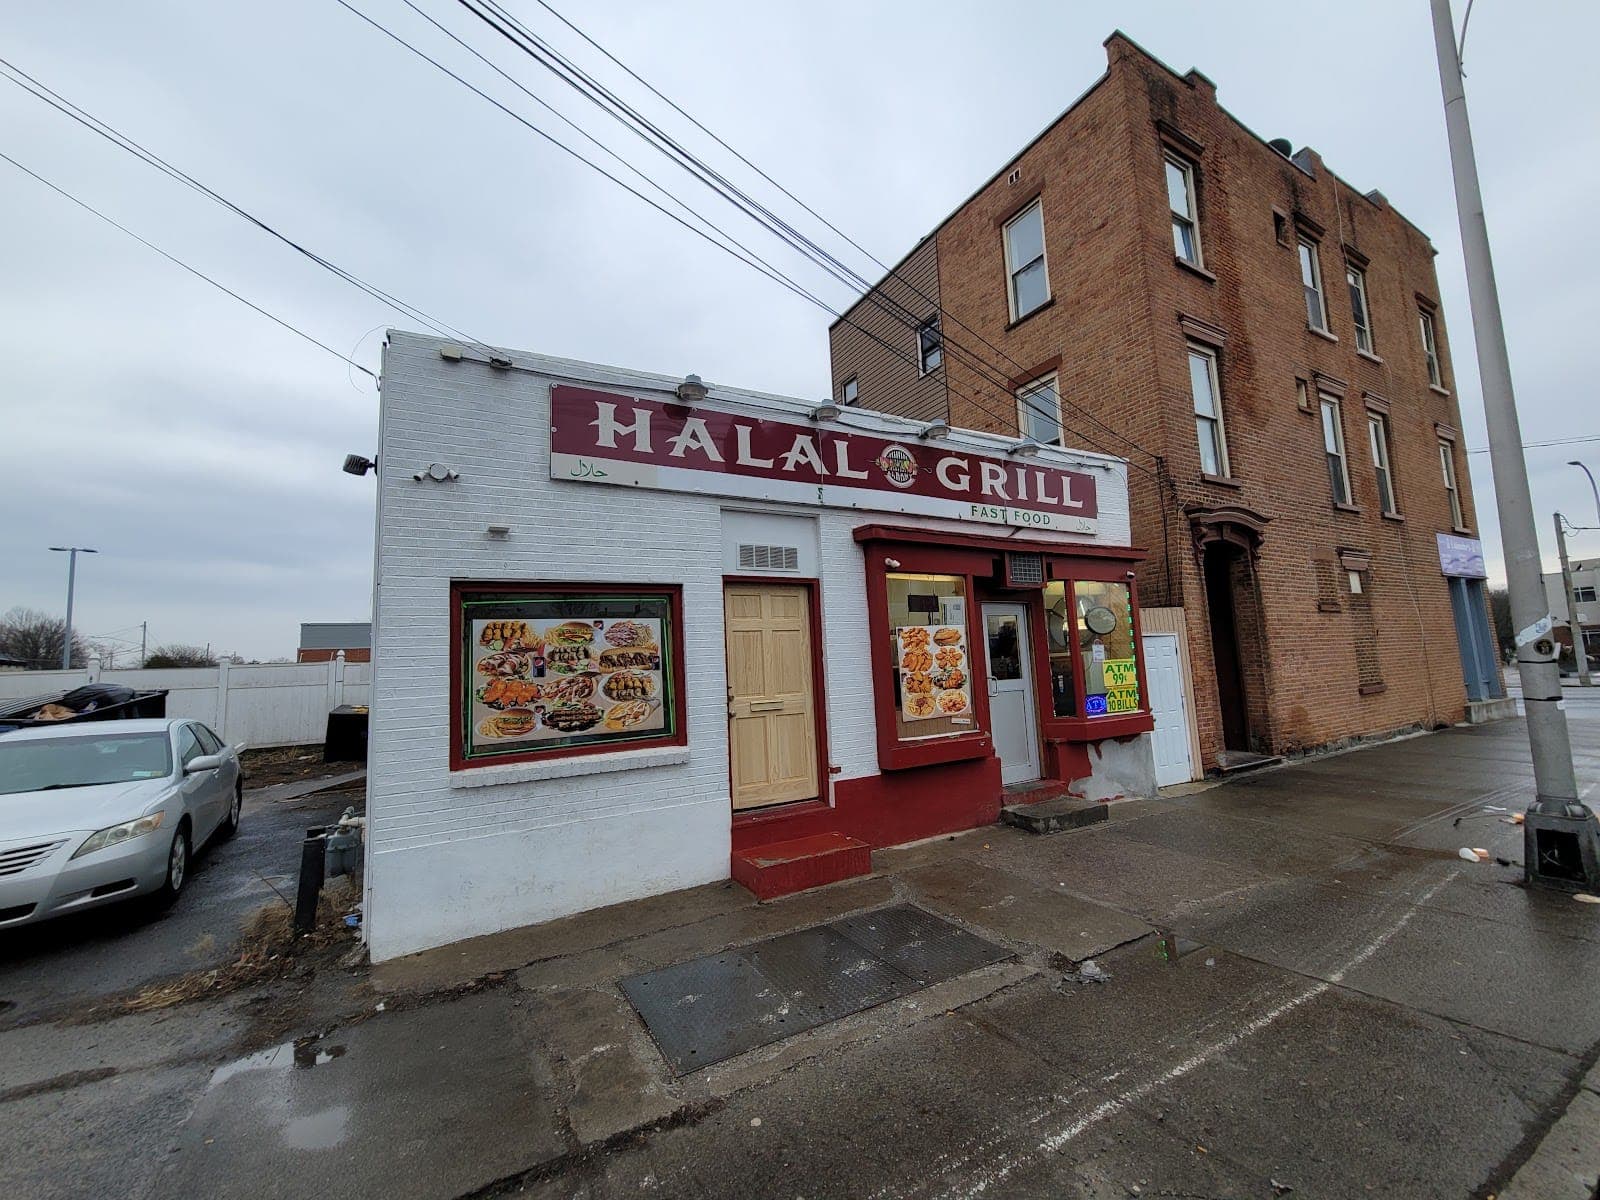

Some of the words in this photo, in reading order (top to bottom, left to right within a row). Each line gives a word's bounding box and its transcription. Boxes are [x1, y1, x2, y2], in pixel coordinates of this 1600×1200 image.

[588, 401, 868, 480] HALAL
[936, 457, 1083, 508] GRILL
[571, 459, 608, 477] حلال
[971, 505, 1007, 520] FAST
[1014, 511, 1050, 525] FOOD
[1105, 664, 1134, 674] ATM
[1108, 690, 1136, 700] ATM
